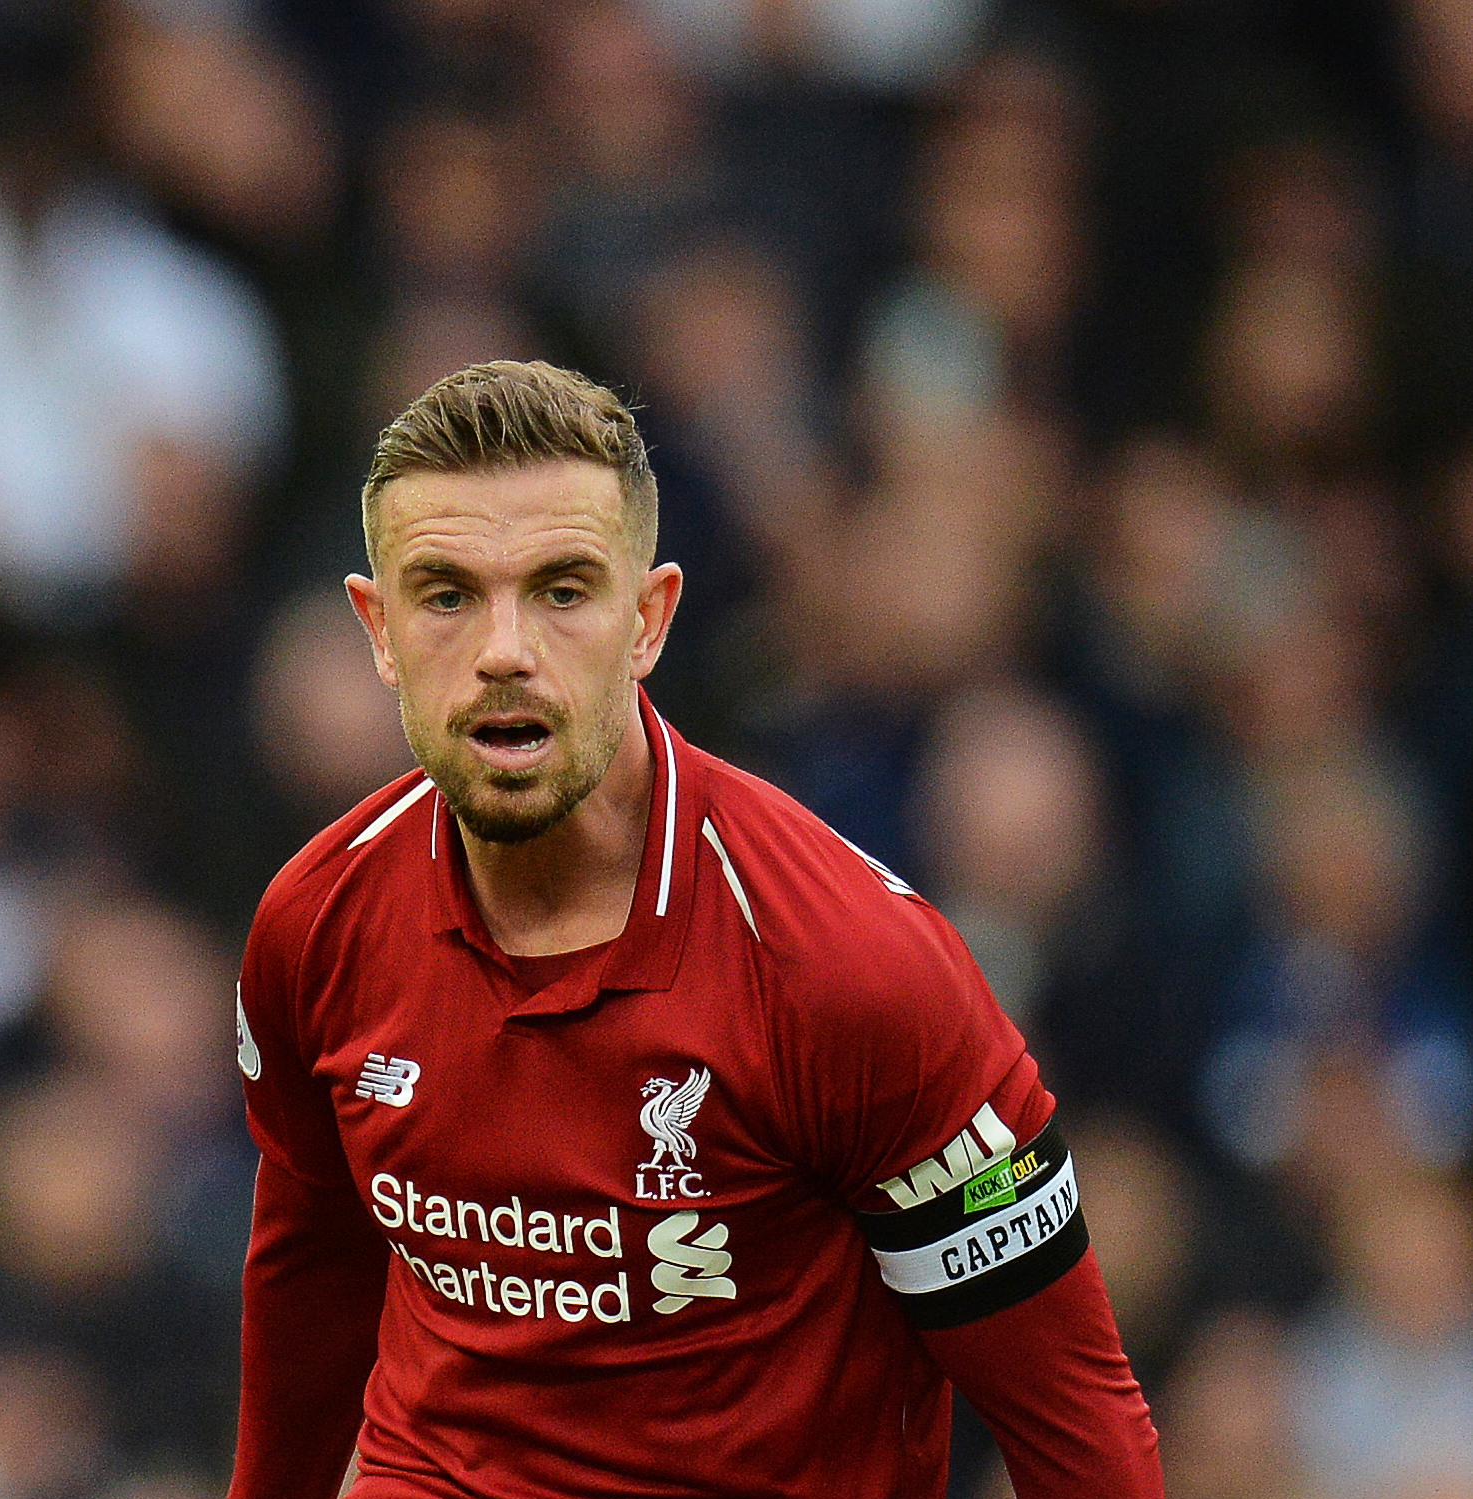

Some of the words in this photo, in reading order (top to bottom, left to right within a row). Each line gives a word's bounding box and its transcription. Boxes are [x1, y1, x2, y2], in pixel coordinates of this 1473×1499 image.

[371, 1172, 623, 1258] Standard
[635, 1172, 712, 1200] L.F.C.
[968, 1174, 1003, 1203] KICK
[1012, 1150, 1039, 1180] OUT
[940, 1179, 1073, 1281] CAPTAIN
[387, 1238, 631, 1323] hartered
